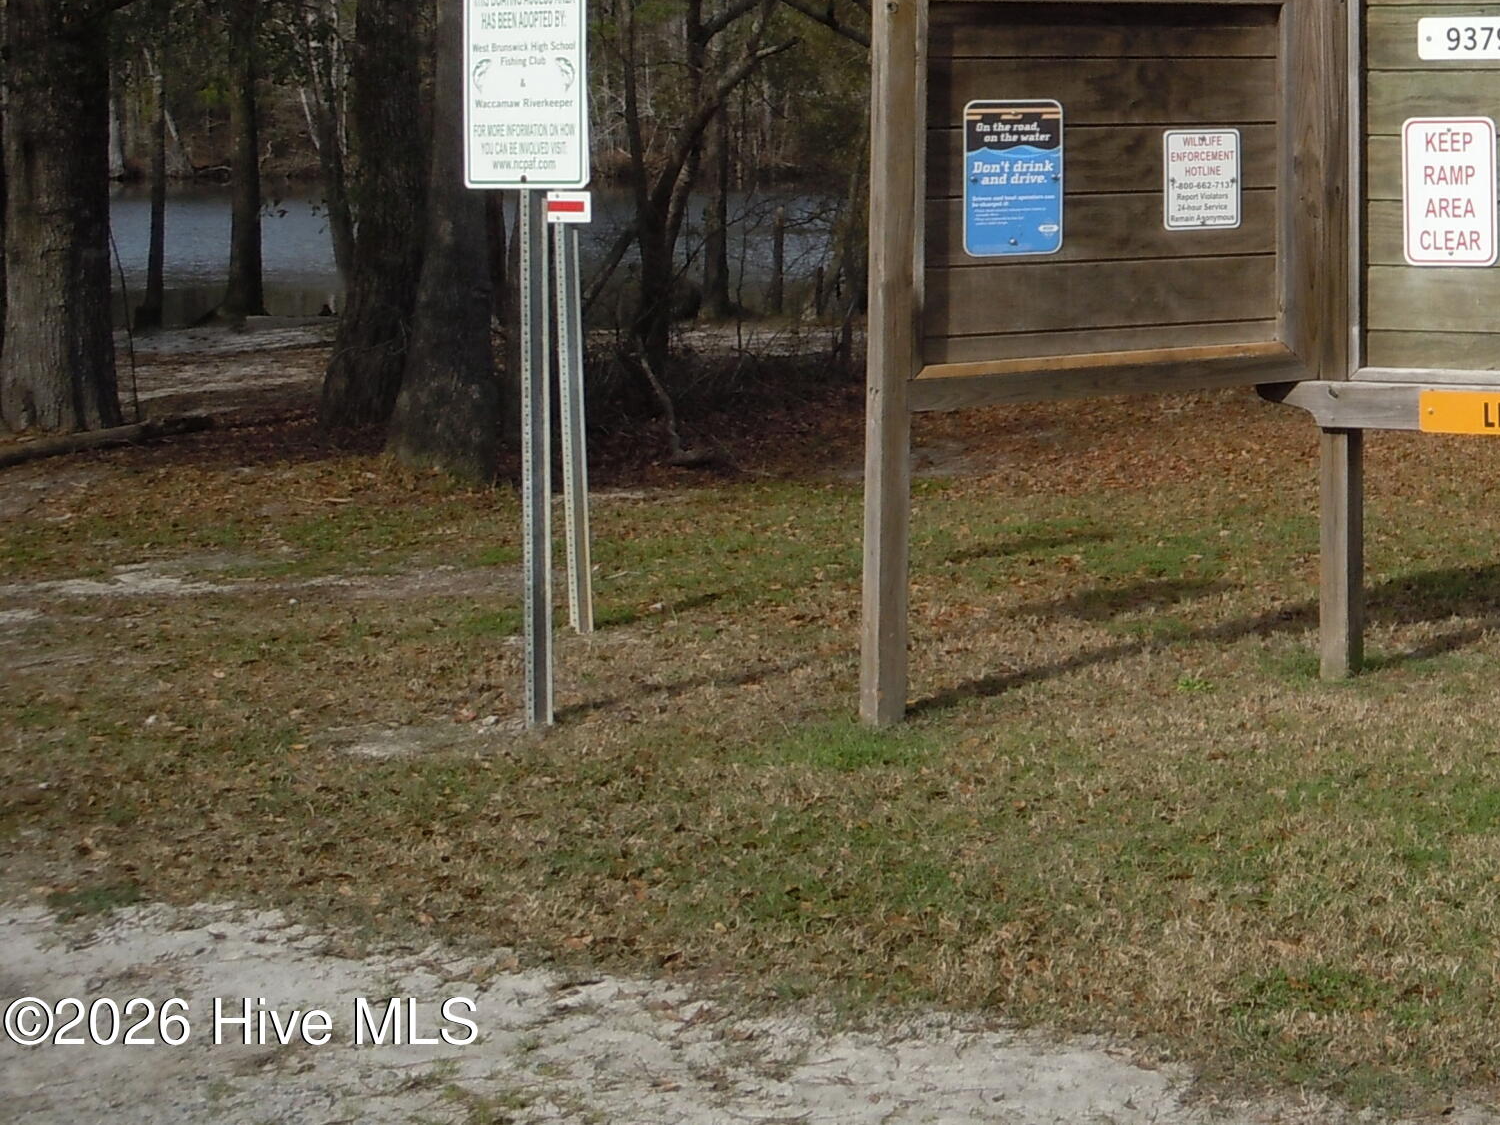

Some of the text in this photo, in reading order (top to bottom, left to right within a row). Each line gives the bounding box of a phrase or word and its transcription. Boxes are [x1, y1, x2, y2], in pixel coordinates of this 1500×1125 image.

[481, 10, 566, 29] HAS BEEN ADOPTED BY:
[473, 41, 576, 52] West Brunswick High School
[501, 56, 546, 67] Fishing Club
[520, 78, 526, 87] &
[475, 98, 573, 108] Waccamaw Riverkeeper
[474, 123, 575, 137] FOR MORE INFORMATION ON HOW
[976, 122, 1040, 131] On the road,
[1000, 133, 1018, 142] the
[1021, 133, 1051, 141] water
[1183, 136, 1222, 147] WILDLIFE
[1425, 132, 1472, 152] KEEP
[1171, 151, 1234, 162] ENFORCEMENT
[493, 157, 556, 173] www.ncpaf.com
[973, 159, 1054, 173] Don't drink
[1185, 166, 1221, 176] HOTLINE
[1424, 165, 1475, 185] RAMP
[981, 173, 1047, 185] and drive.
[1204, 203, 1227, 211] Service
[1425, 198, 1475, 218] AREA
[1420, 230, 1481, 250] CLEAR
